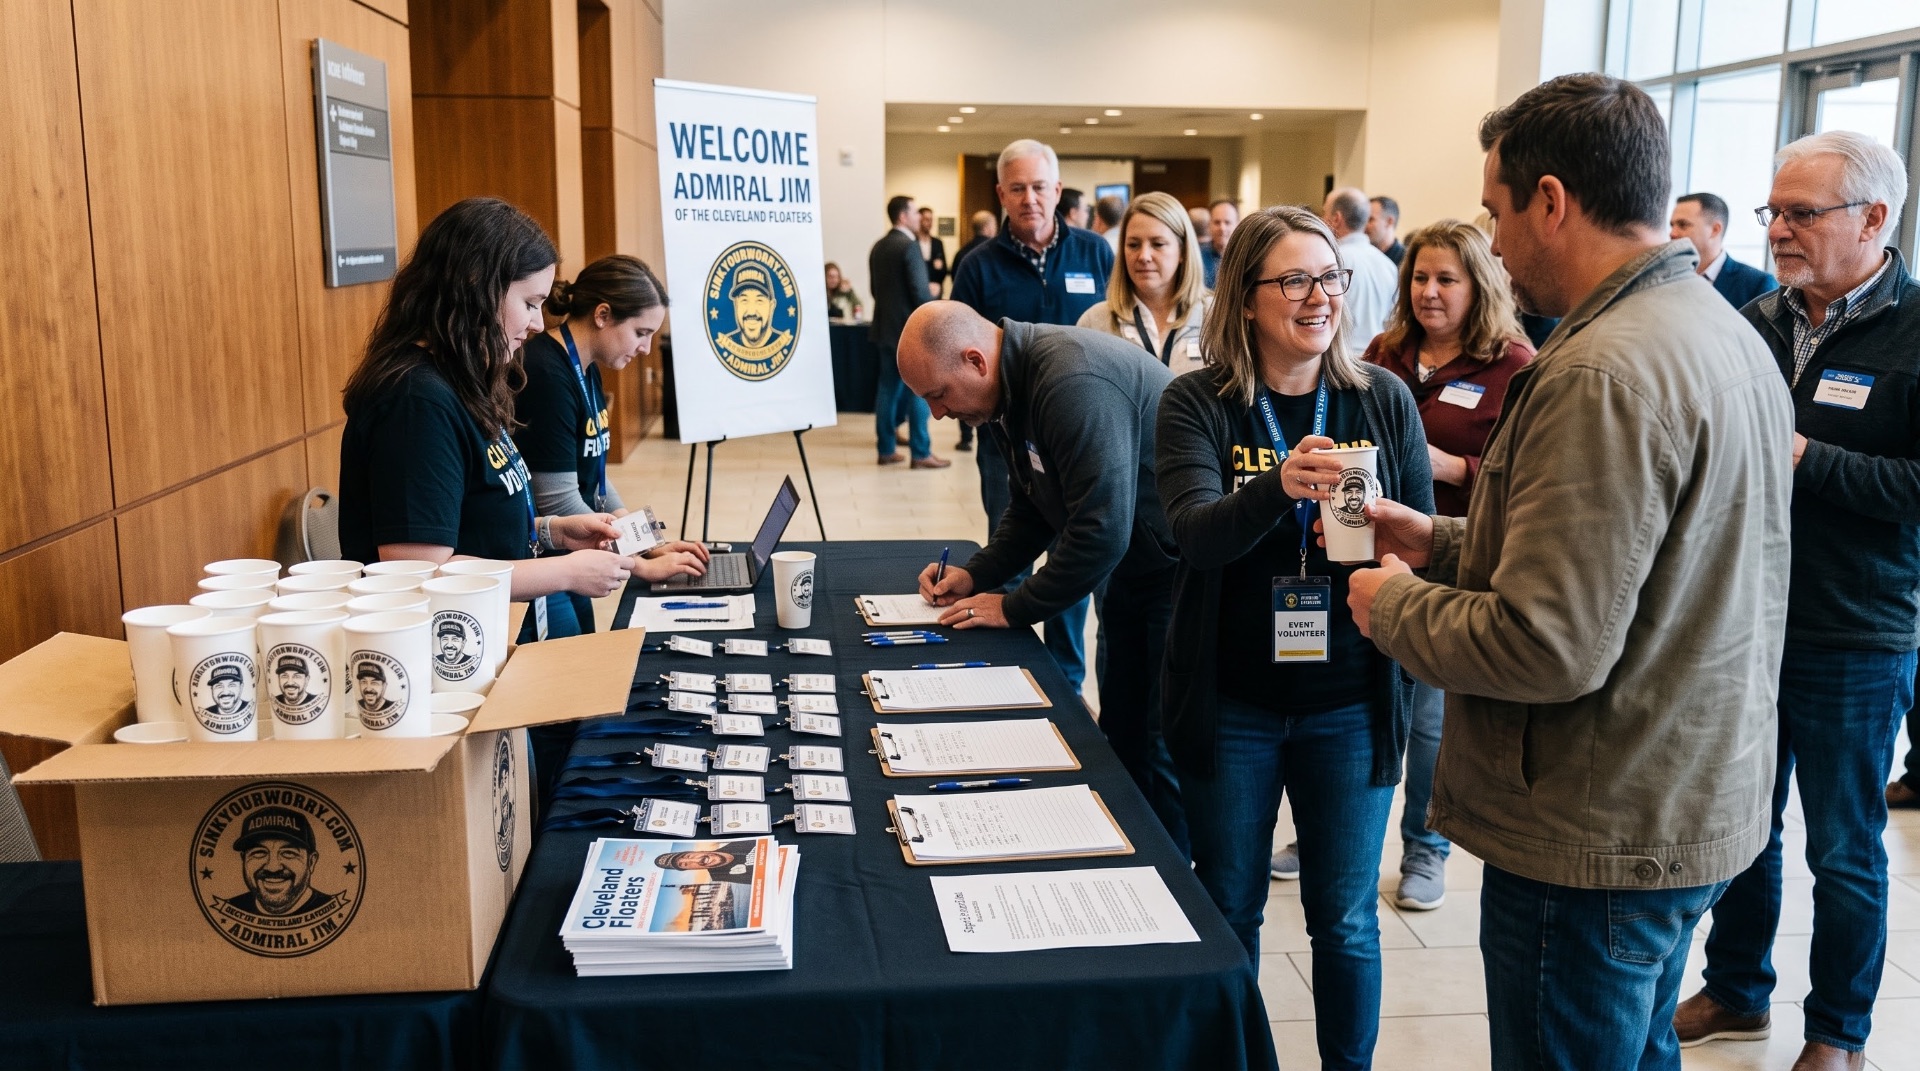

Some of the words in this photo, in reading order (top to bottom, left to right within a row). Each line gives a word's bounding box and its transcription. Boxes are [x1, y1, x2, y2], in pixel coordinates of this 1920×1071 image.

[669, 122, 809, 166] WELCOME
[674, 172, 773, 202] ADMIRAL
[779, 177, 811, 203] JIM
[675, 208, 688, 221] OF
[691, 209, 710, 222] THE
[712, 209, 766, 223] CLEVELAND
[769, 211, 813, 224] FLOATERS
[709, 248, 795, 299] SINKYOURWORRY.COM
[726, 353, 770, 375] ADMIRAL
[770, 350, 785, 369] JIM
[200, 789, 355, 858] SINKYOURWORRY.COM
[248, 815, 301, 831] ADMIRAL
[582, 867, 624, 930] Cleveland
[608, 876, 646, 928] Floaters
[228, 922, 309, 949] ADMIRAL
[310, 917, 338, 943] JIM
